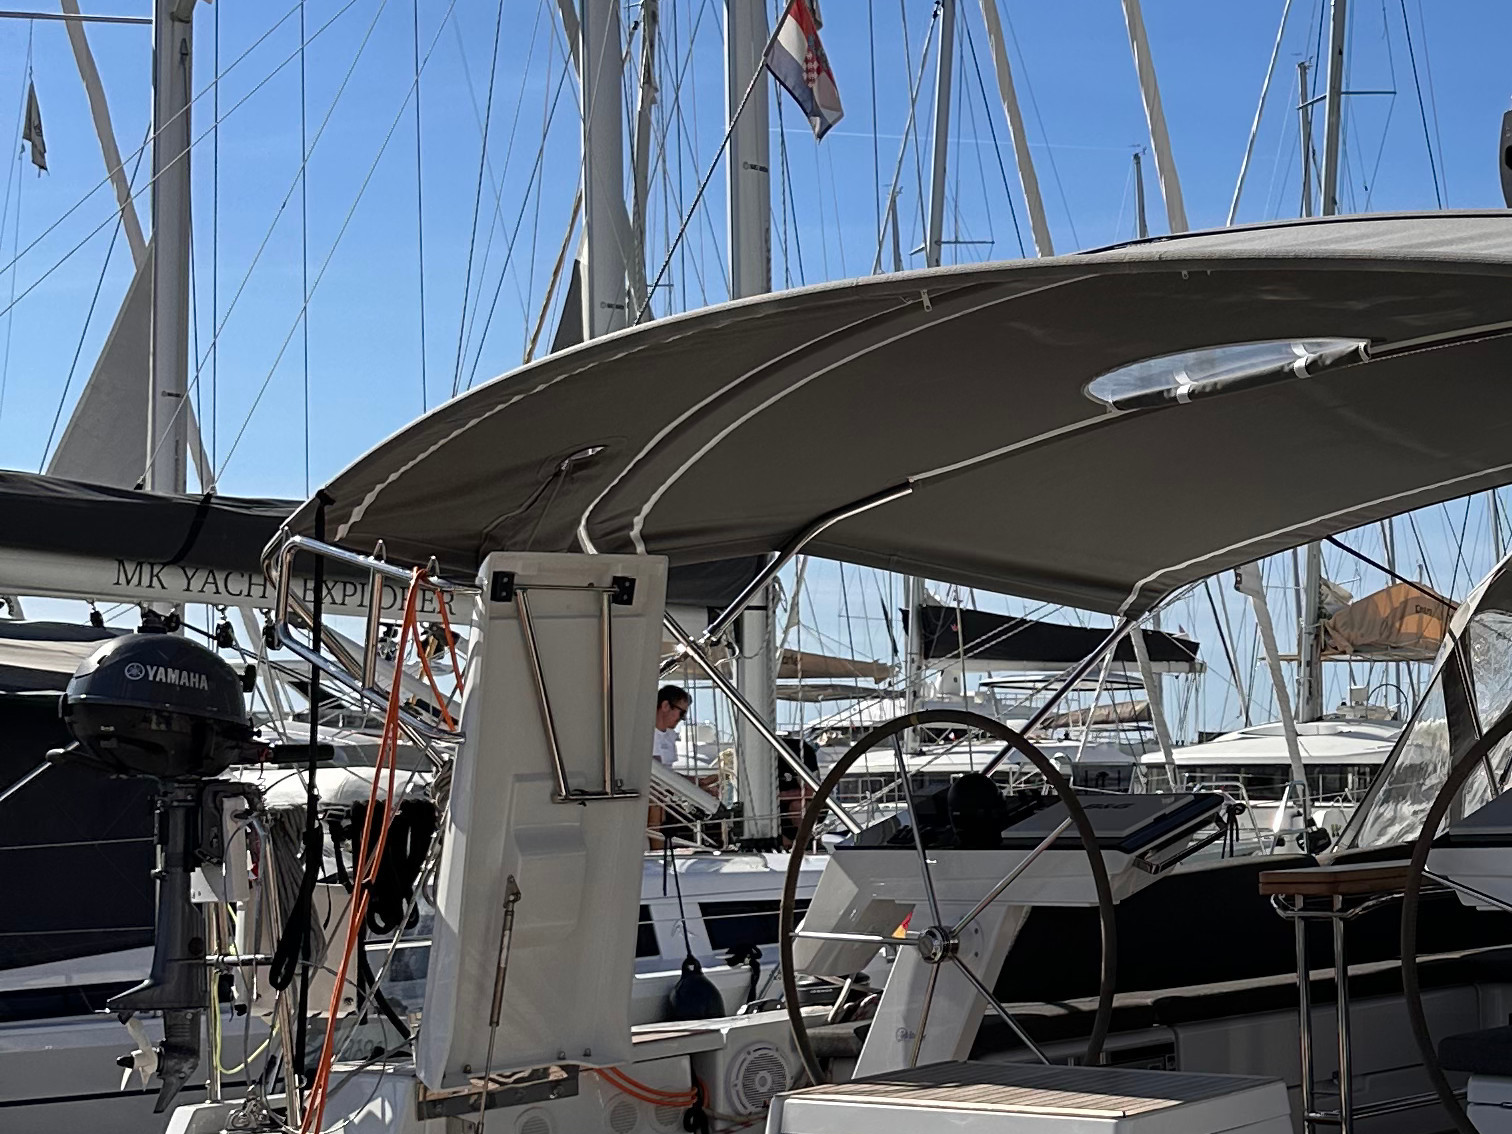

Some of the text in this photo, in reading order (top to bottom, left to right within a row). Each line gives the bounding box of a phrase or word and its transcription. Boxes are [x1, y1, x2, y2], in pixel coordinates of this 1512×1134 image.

[112, 558, 168, 590] MK
[178, 566, 269, 599] YACH
[146, 664, 209, 690] YAMAHA
